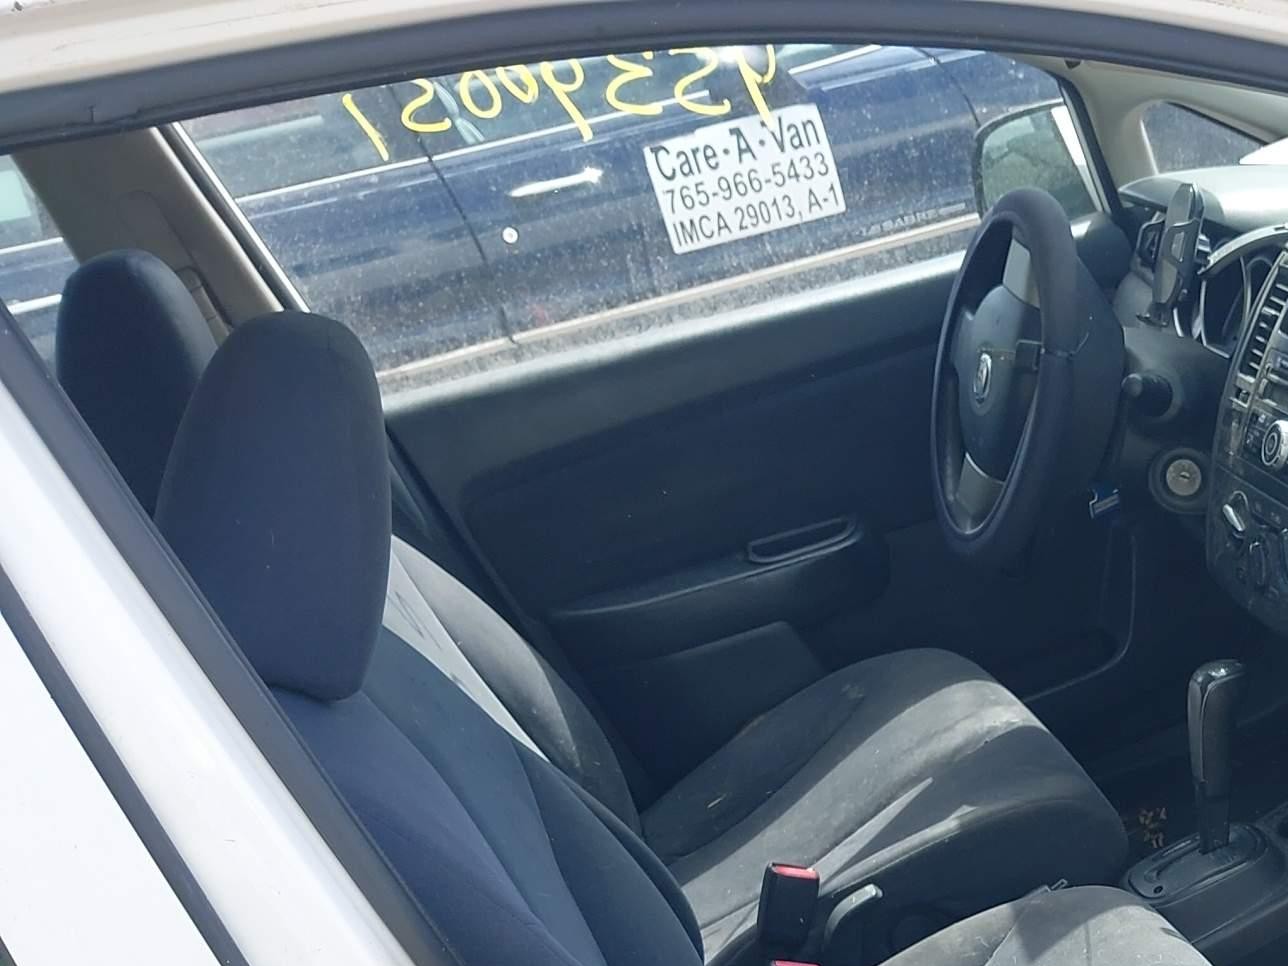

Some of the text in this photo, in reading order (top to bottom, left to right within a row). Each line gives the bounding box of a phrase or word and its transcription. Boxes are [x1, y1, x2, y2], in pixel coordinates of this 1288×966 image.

[663, 152, 830, 214] 765-966-5433
[673, 182, 840, 247] IMCA 29013, A-1
